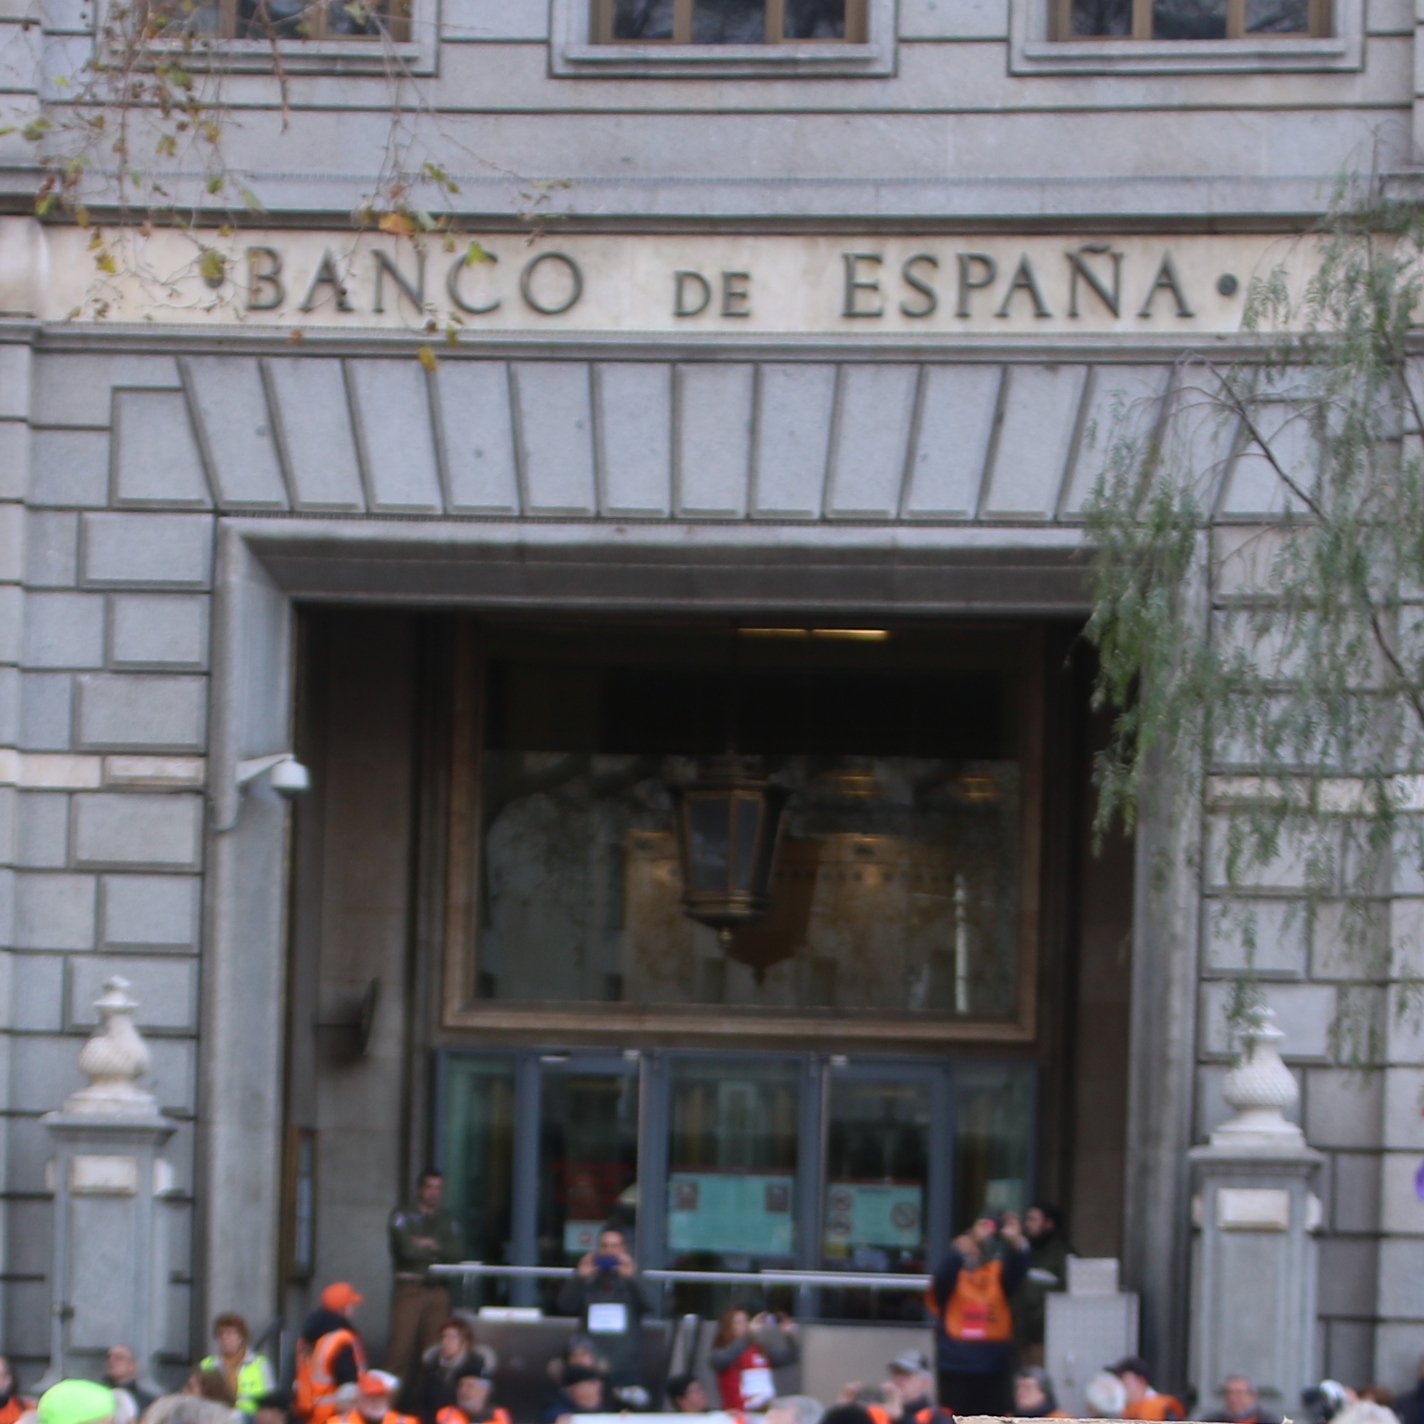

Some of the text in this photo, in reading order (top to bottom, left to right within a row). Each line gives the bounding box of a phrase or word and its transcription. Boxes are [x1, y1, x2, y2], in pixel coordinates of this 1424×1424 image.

[245, 243, 1196, 320] BANCO DE ESPAÑA
